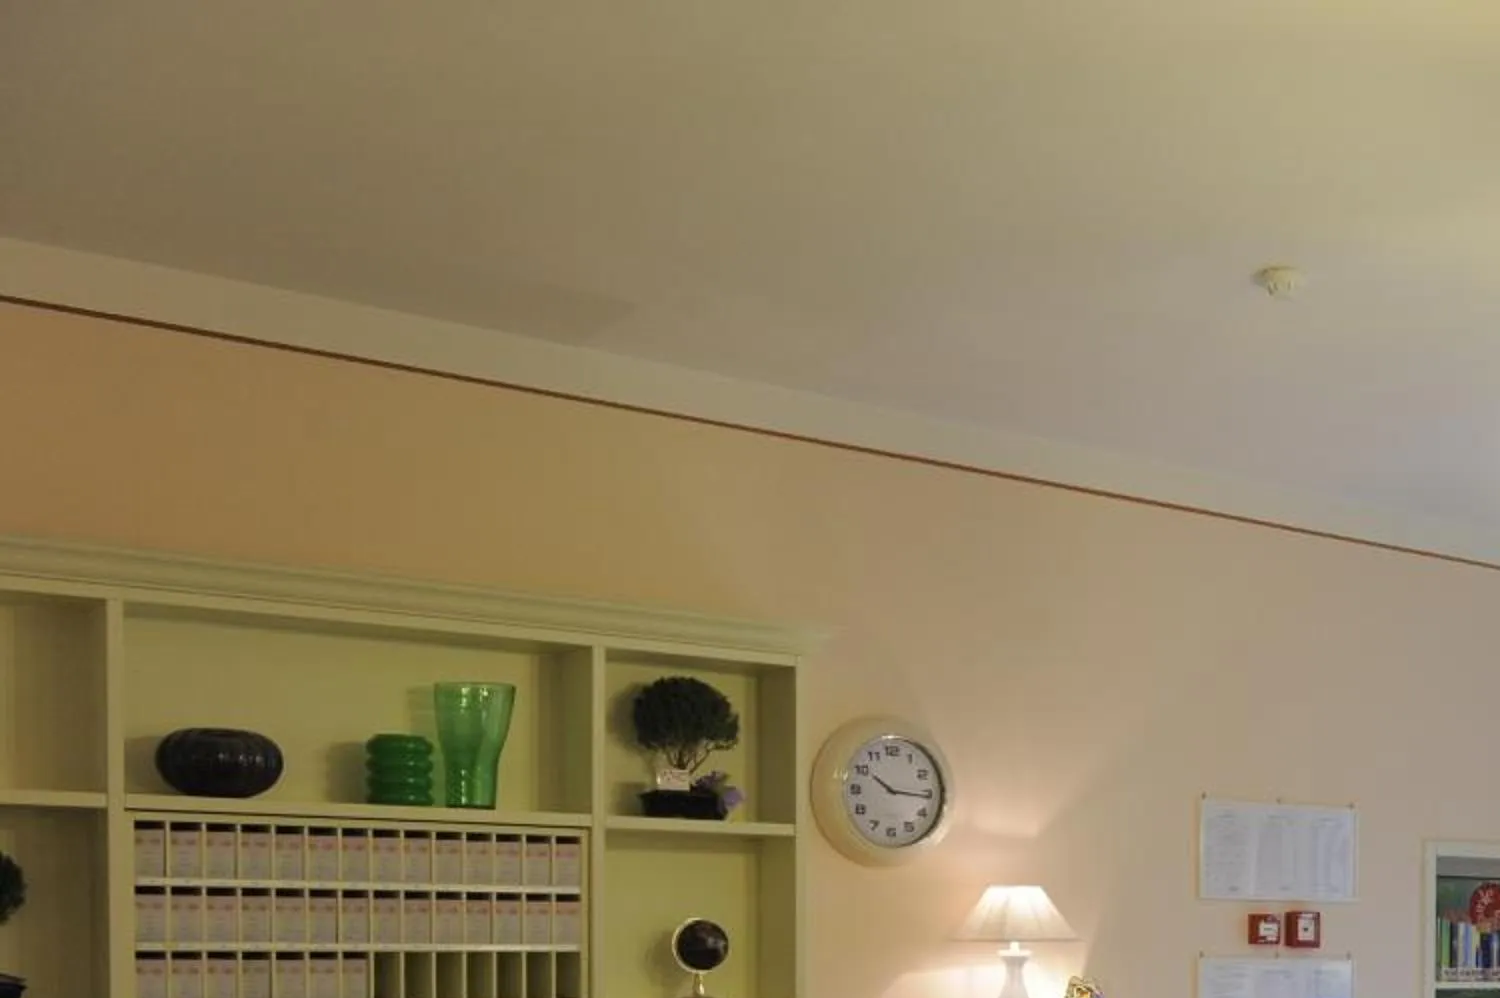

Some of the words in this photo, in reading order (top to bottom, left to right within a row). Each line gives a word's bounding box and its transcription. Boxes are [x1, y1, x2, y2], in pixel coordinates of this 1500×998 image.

[867, 751, 880, 761] 11
[885, 745, 900, 757] 12
[907, 753, 913, 765] 1
[854, 764, 869, 776] 10
[917, 769, 929, 780] 2
[850, 783, 861, 795] 9
[855, 803, 866, 815] 8
[917, 807, 928, 818] 4
[868, 819, 880, 831] 7
[903, 821, 915, 833] 5
[886, 827, 897, 838] 6
